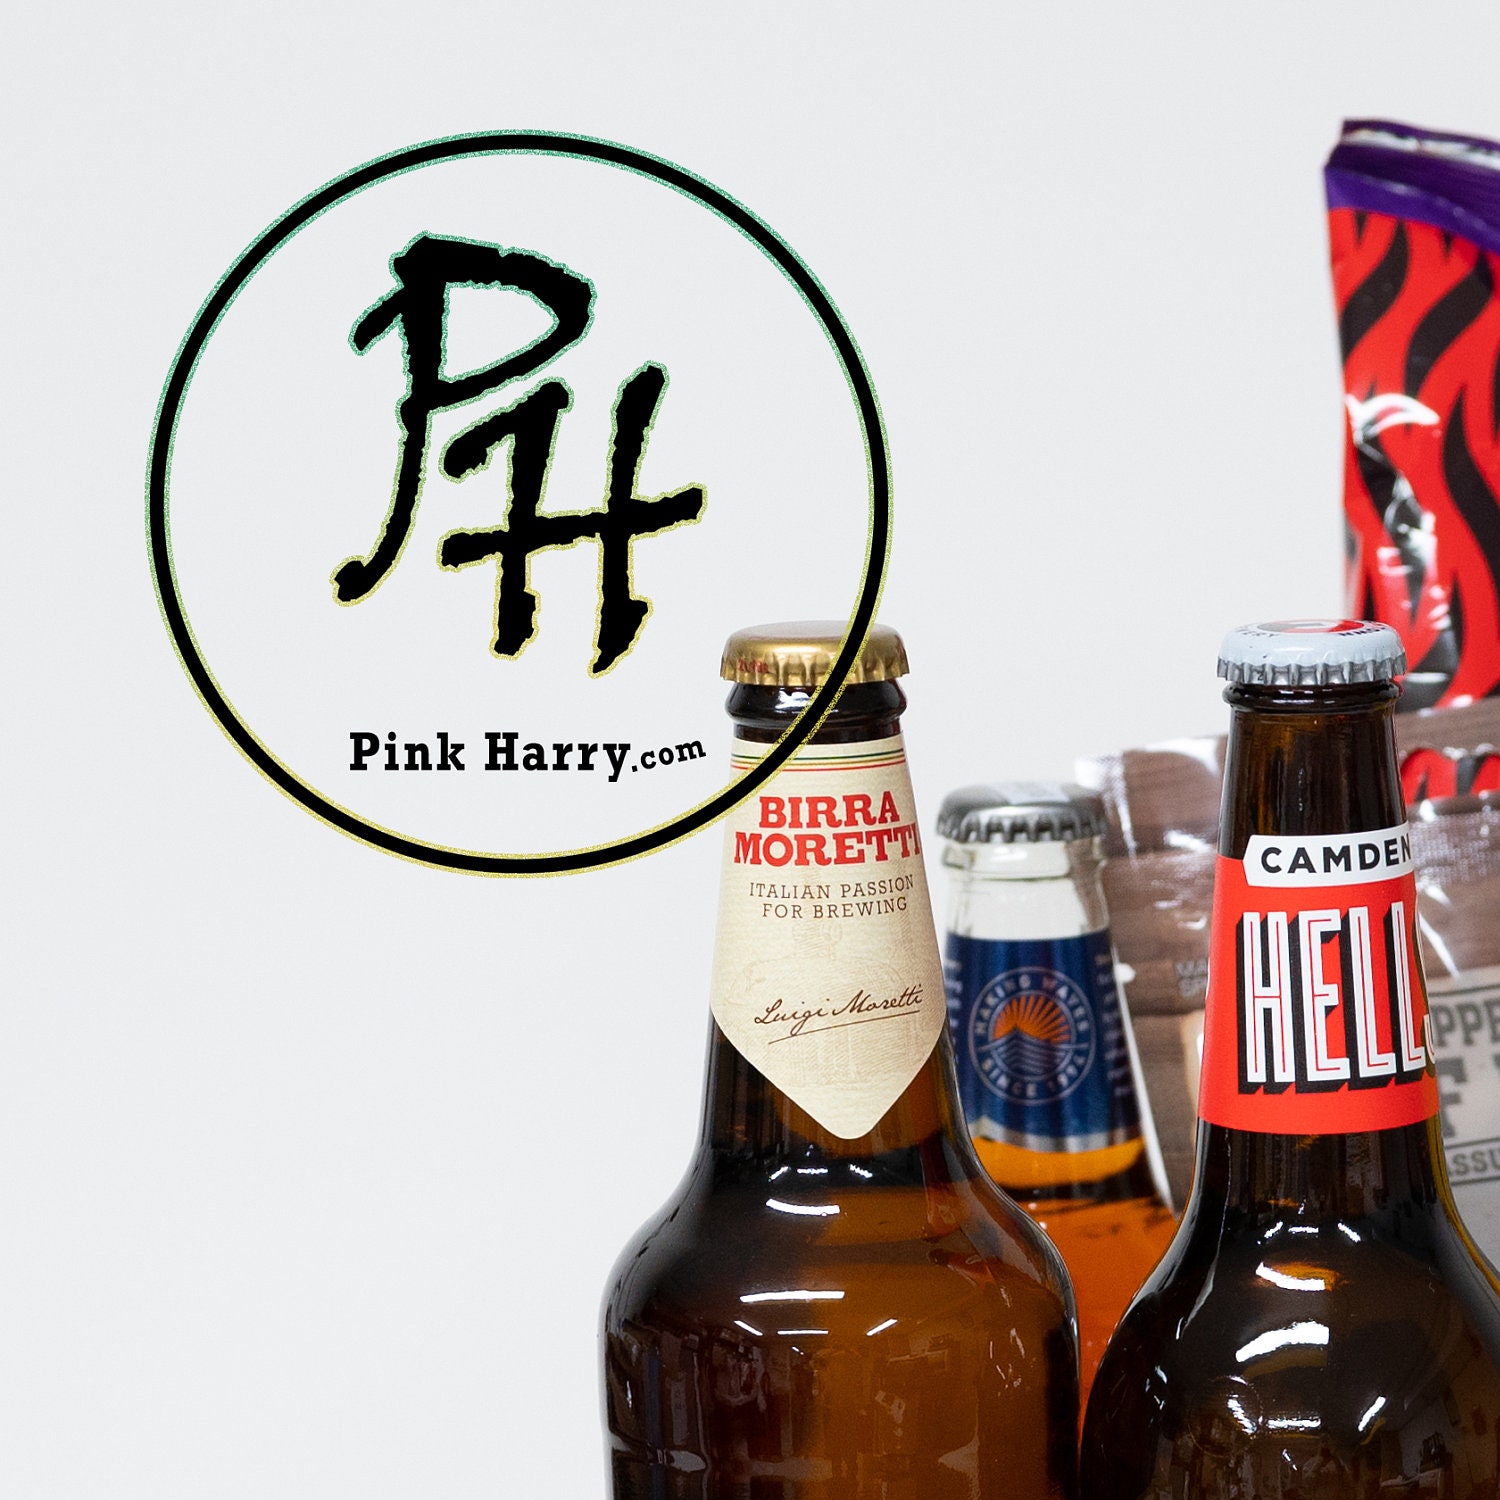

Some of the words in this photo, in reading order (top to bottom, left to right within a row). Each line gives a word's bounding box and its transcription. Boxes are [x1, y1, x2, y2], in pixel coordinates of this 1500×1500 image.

[759, 791, 900, 829] BIRRA
[734, 823, 921, 868] MORETTI
[1260, 838, 1412, 875] CAMDEN
[750, 881, 831, 899] ITALIAN
[841, 874, 914, 898] PASSION
[762, 903, 803, 919] FOR
[813, 897, 908, 919] BREWING
[754, 998, 830, 1036] Luigi
[831, 983, 924, 1016] Moretti
[1236, 901, 1436, 1095] HELL
